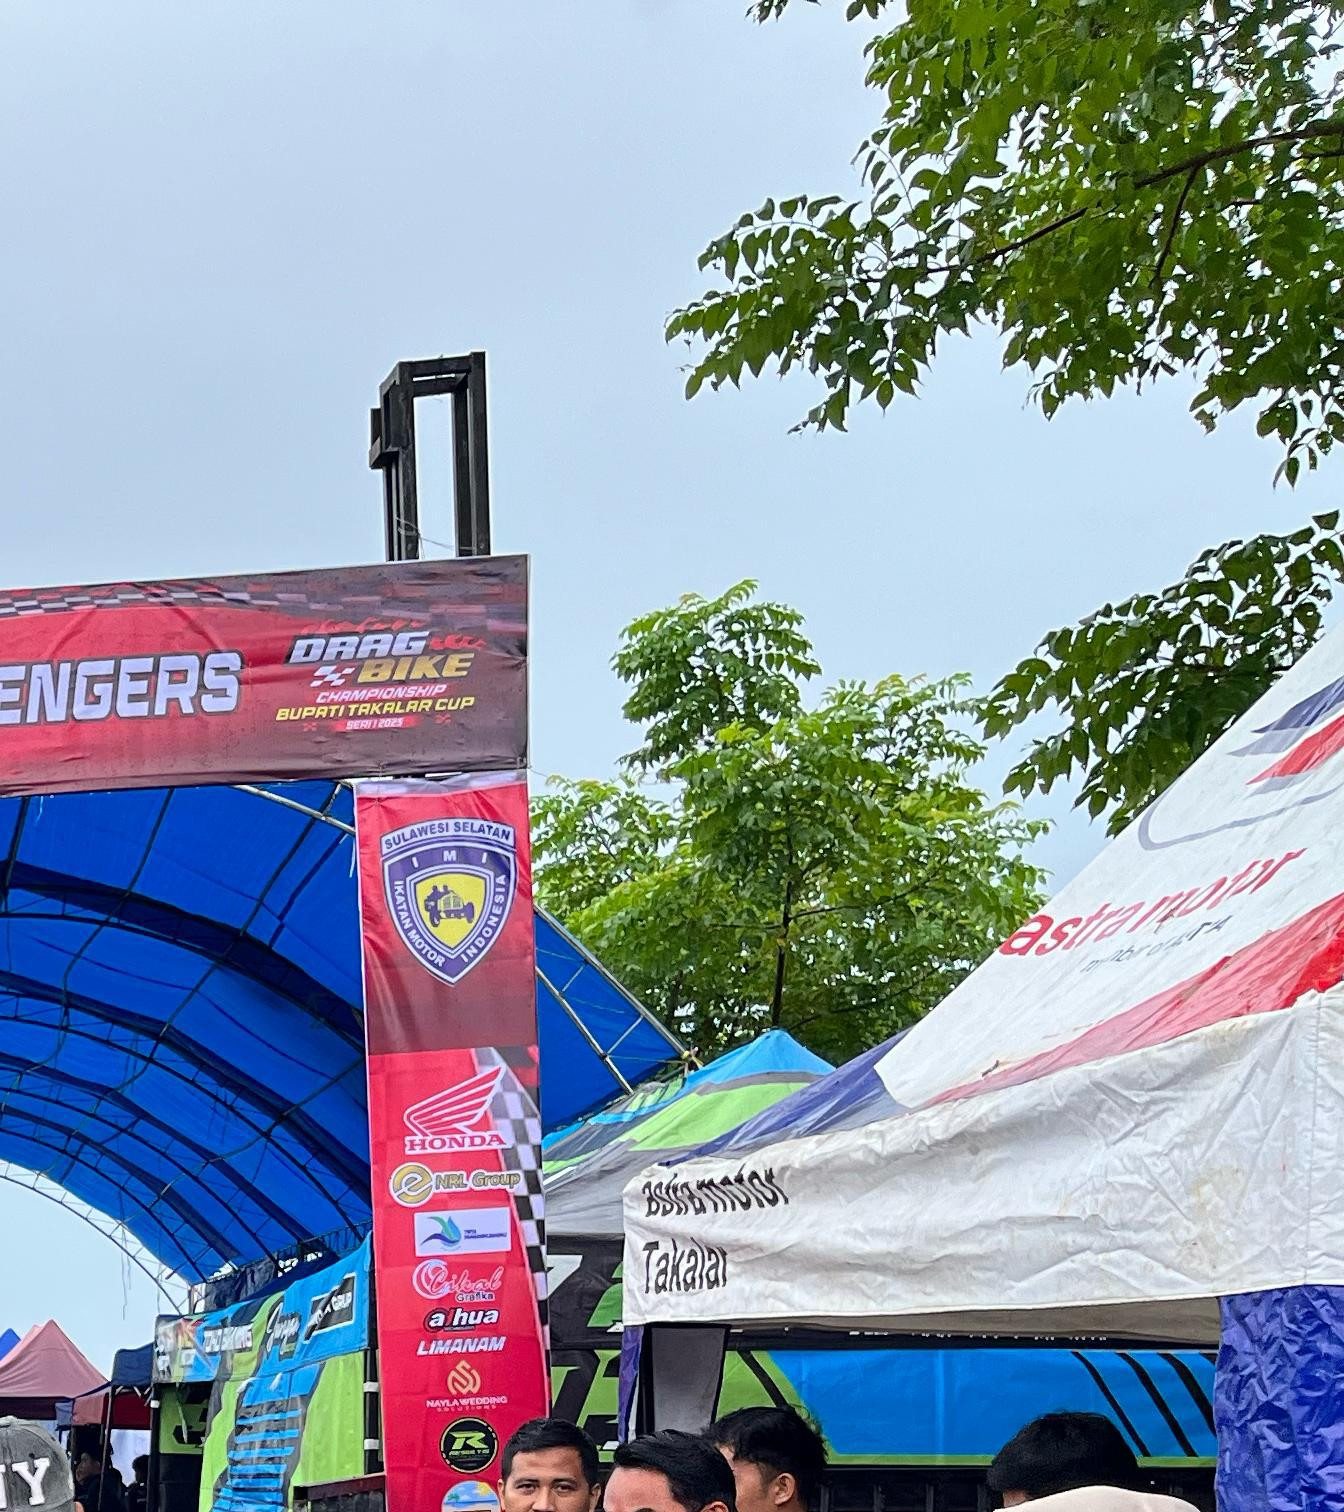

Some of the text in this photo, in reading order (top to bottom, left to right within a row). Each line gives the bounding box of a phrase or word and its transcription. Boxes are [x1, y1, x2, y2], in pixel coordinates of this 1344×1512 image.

[289, 631, 429, 664] DRAG
[357, 653, 475, 683] BIKE
[275, 697, 475, 721] BUPATI TAKALAR CUP
[316, 684, 447, 704] CHAMPIONSHIP
[384, 821, 511, 850] SULAWESI SELATAN
[393, 880, 413, 930] IKATAN
[461, 874, 507, 963] INDONESIA
[998, 900, 1146, 957] astra
[407, 929, 446, 968] MOTOR
[407, 1134, 506, 1151] HONDA
[472, 1171, 520, 1190] Group
[642, 1164, 789, 1217] astra motor
[642, 1237, 728, 1295] Takalar
[416, 1336, 506, 1356] LIMANAM
[426, 1396, 508, 1408] NAYLA WEDDING
